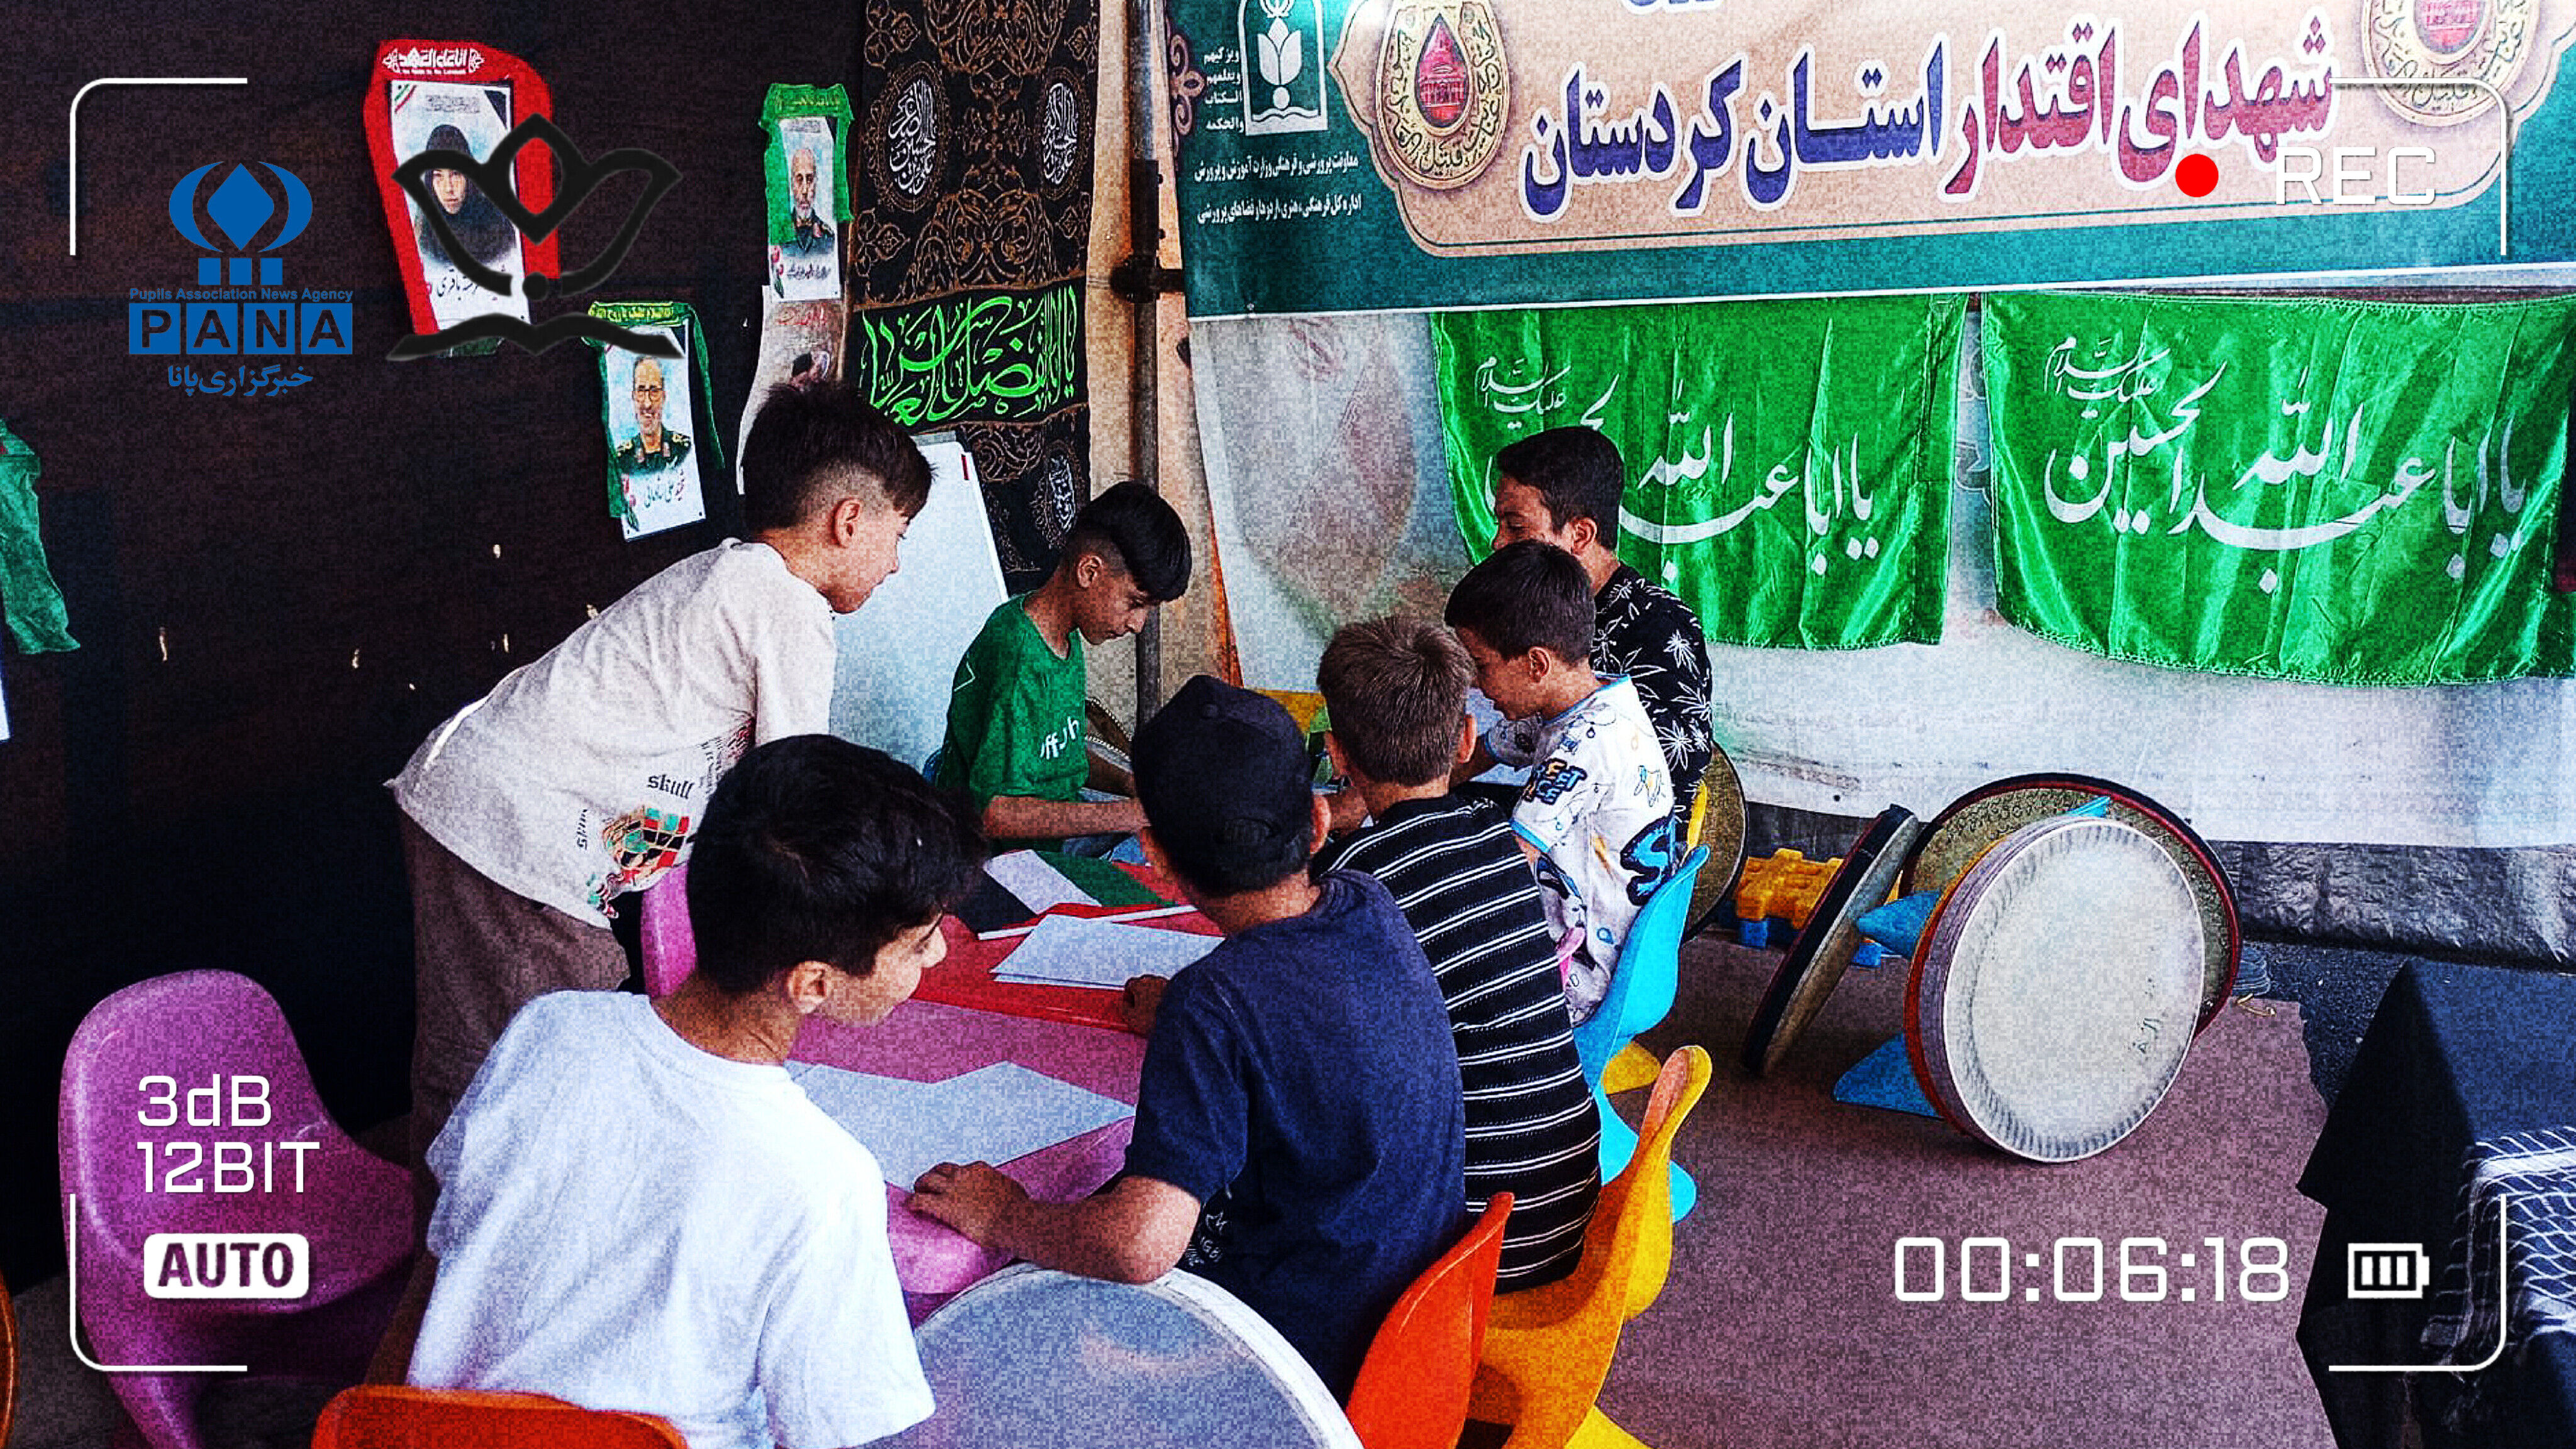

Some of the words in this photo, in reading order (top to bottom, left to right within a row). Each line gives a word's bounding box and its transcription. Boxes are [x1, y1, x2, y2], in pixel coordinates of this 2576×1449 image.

[1523, 58, 1743, 217] کردستان
[1743, 39, 1944, 206] استان
[1943, 19, 2118, 196] اقتدار
[2117, 13, 2334, 185] شهدای
[647, 774, 696, 800] skull
